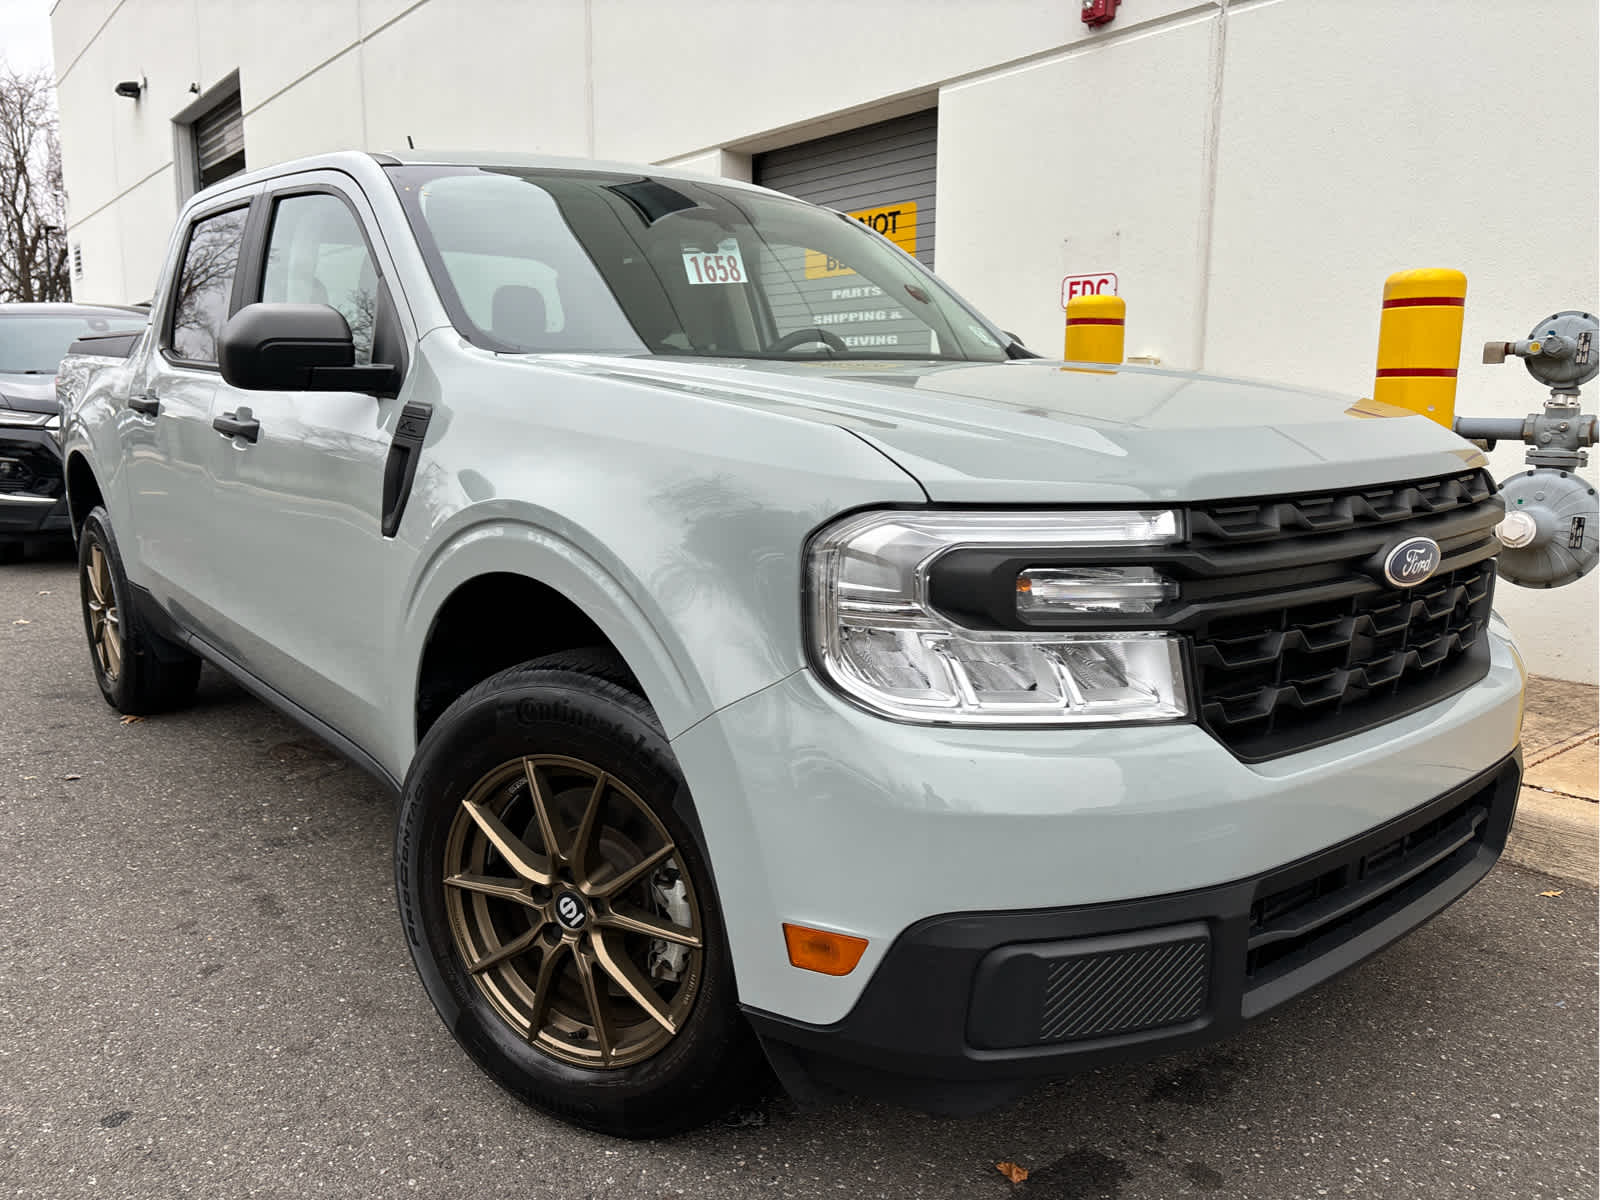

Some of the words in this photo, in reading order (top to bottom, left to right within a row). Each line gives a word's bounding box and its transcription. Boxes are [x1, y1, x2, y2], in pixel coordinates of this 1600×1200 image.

[689, 255, 741, 283] 1658
[831, 286, 883, 300] PARTS
[813, 311, 886, 325] SHIPPING
[887, 310, 903, 320] &
[1402, 548, 1433, 577] Ford
